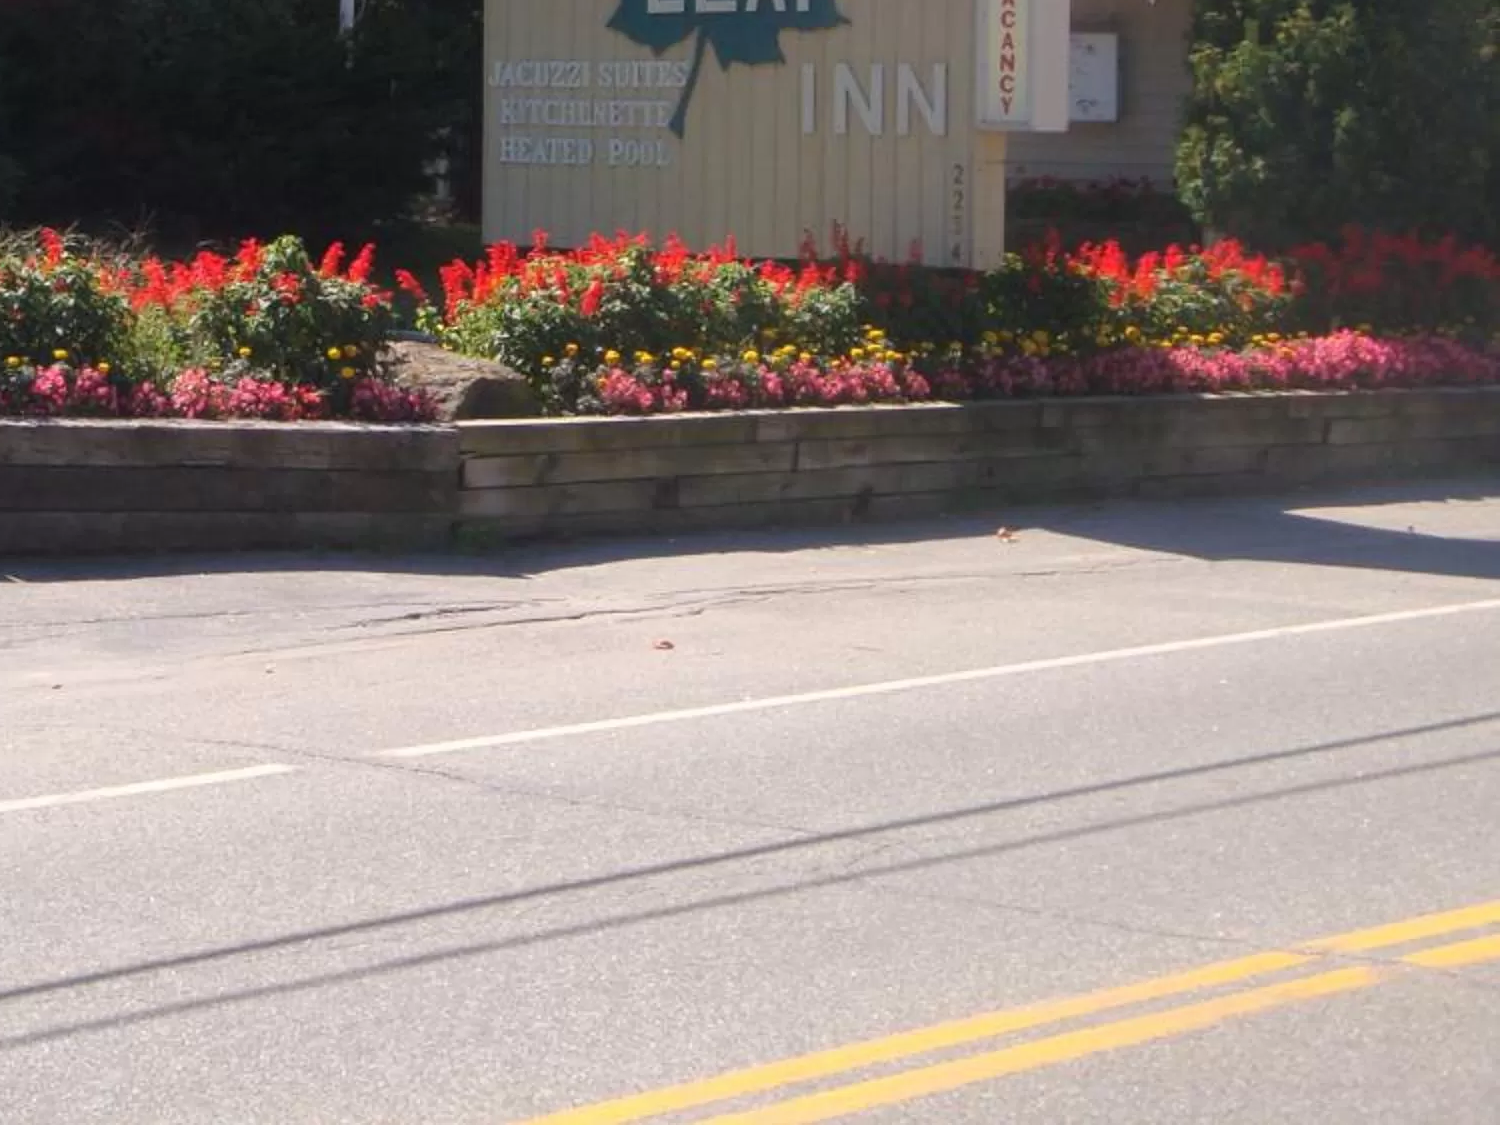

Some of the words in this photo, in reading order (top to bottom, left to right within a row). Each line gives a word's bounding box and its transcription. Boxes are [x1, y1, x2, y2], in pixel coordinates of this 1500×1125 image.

[488, 60, 590, 88] JACUZZI
[597, 59, 689, 88] SUITES
[802, 62, 948, 136] INN
[499, 136, 593, 164] HEATED
[608, 138, 670, 166] POOL
